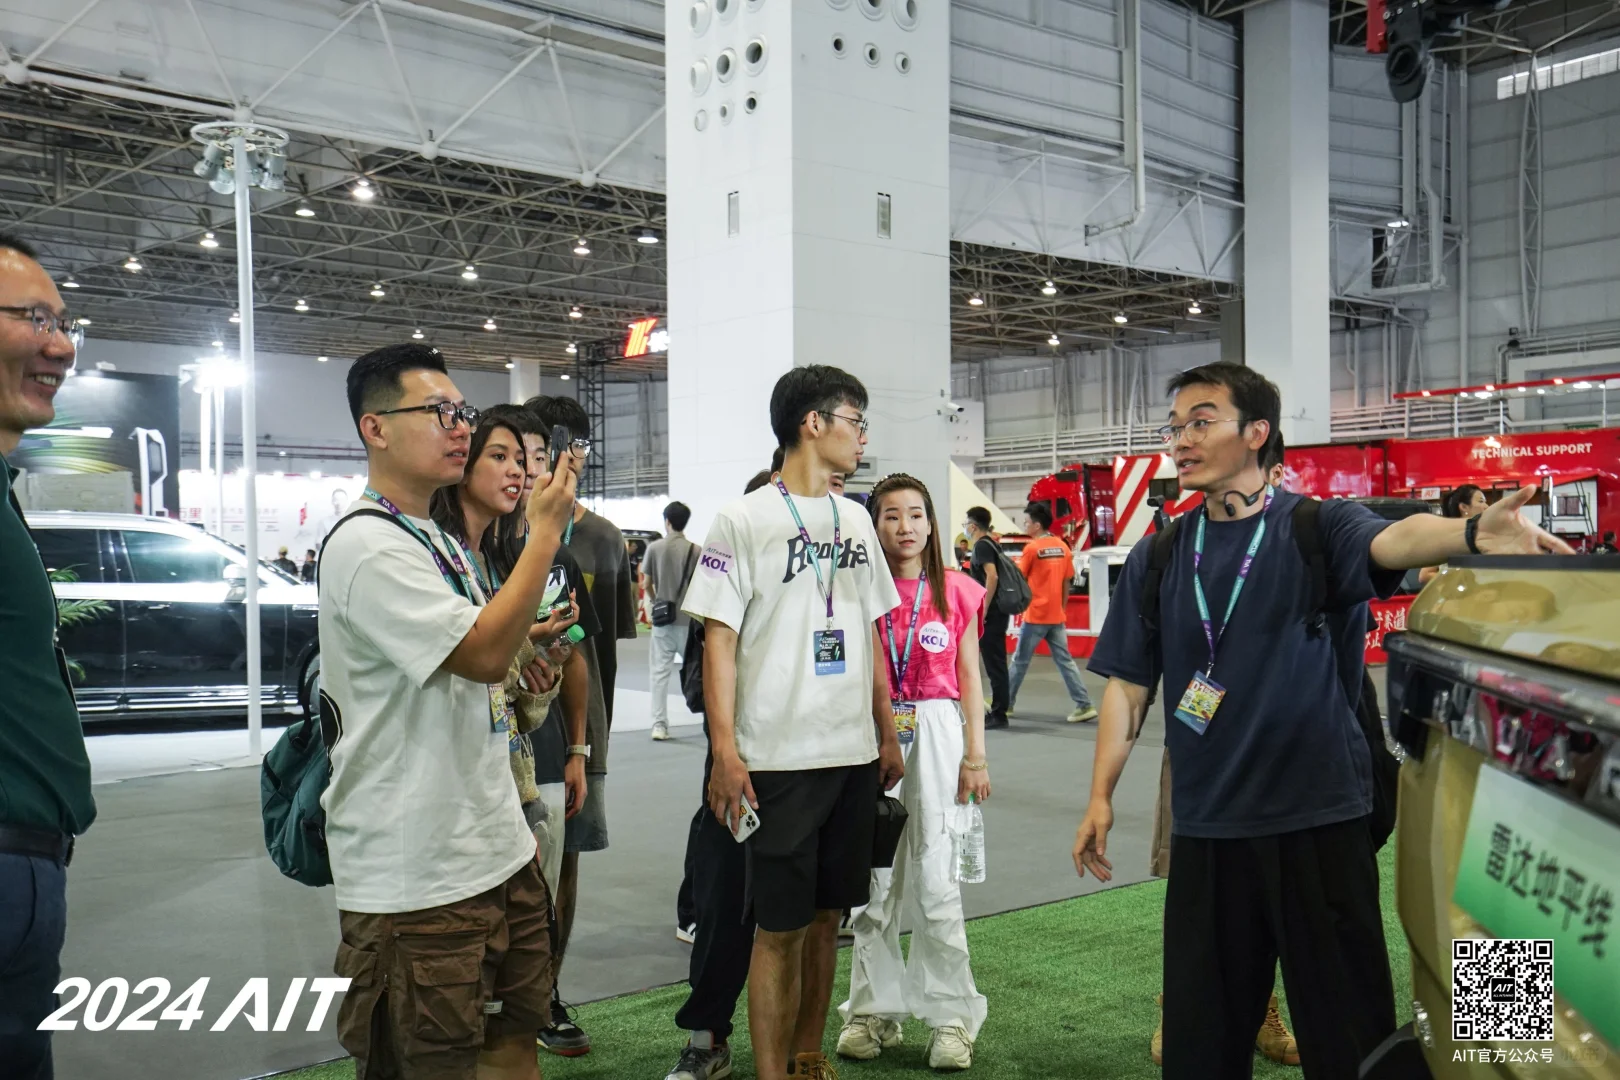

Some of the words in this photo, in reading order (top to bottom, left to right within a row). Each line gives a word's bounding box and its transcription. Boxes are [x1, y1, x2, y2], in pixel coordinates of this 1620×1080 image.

[1472, 446, 1533, 459] TECHNICAL
[1536, 443, 1592, 456] SUPPORT
[700, 554, 728, 574] KOL
[921, 634, 946, 648] KOL
[1486, 821, 1613, 959] 雷达地平线
